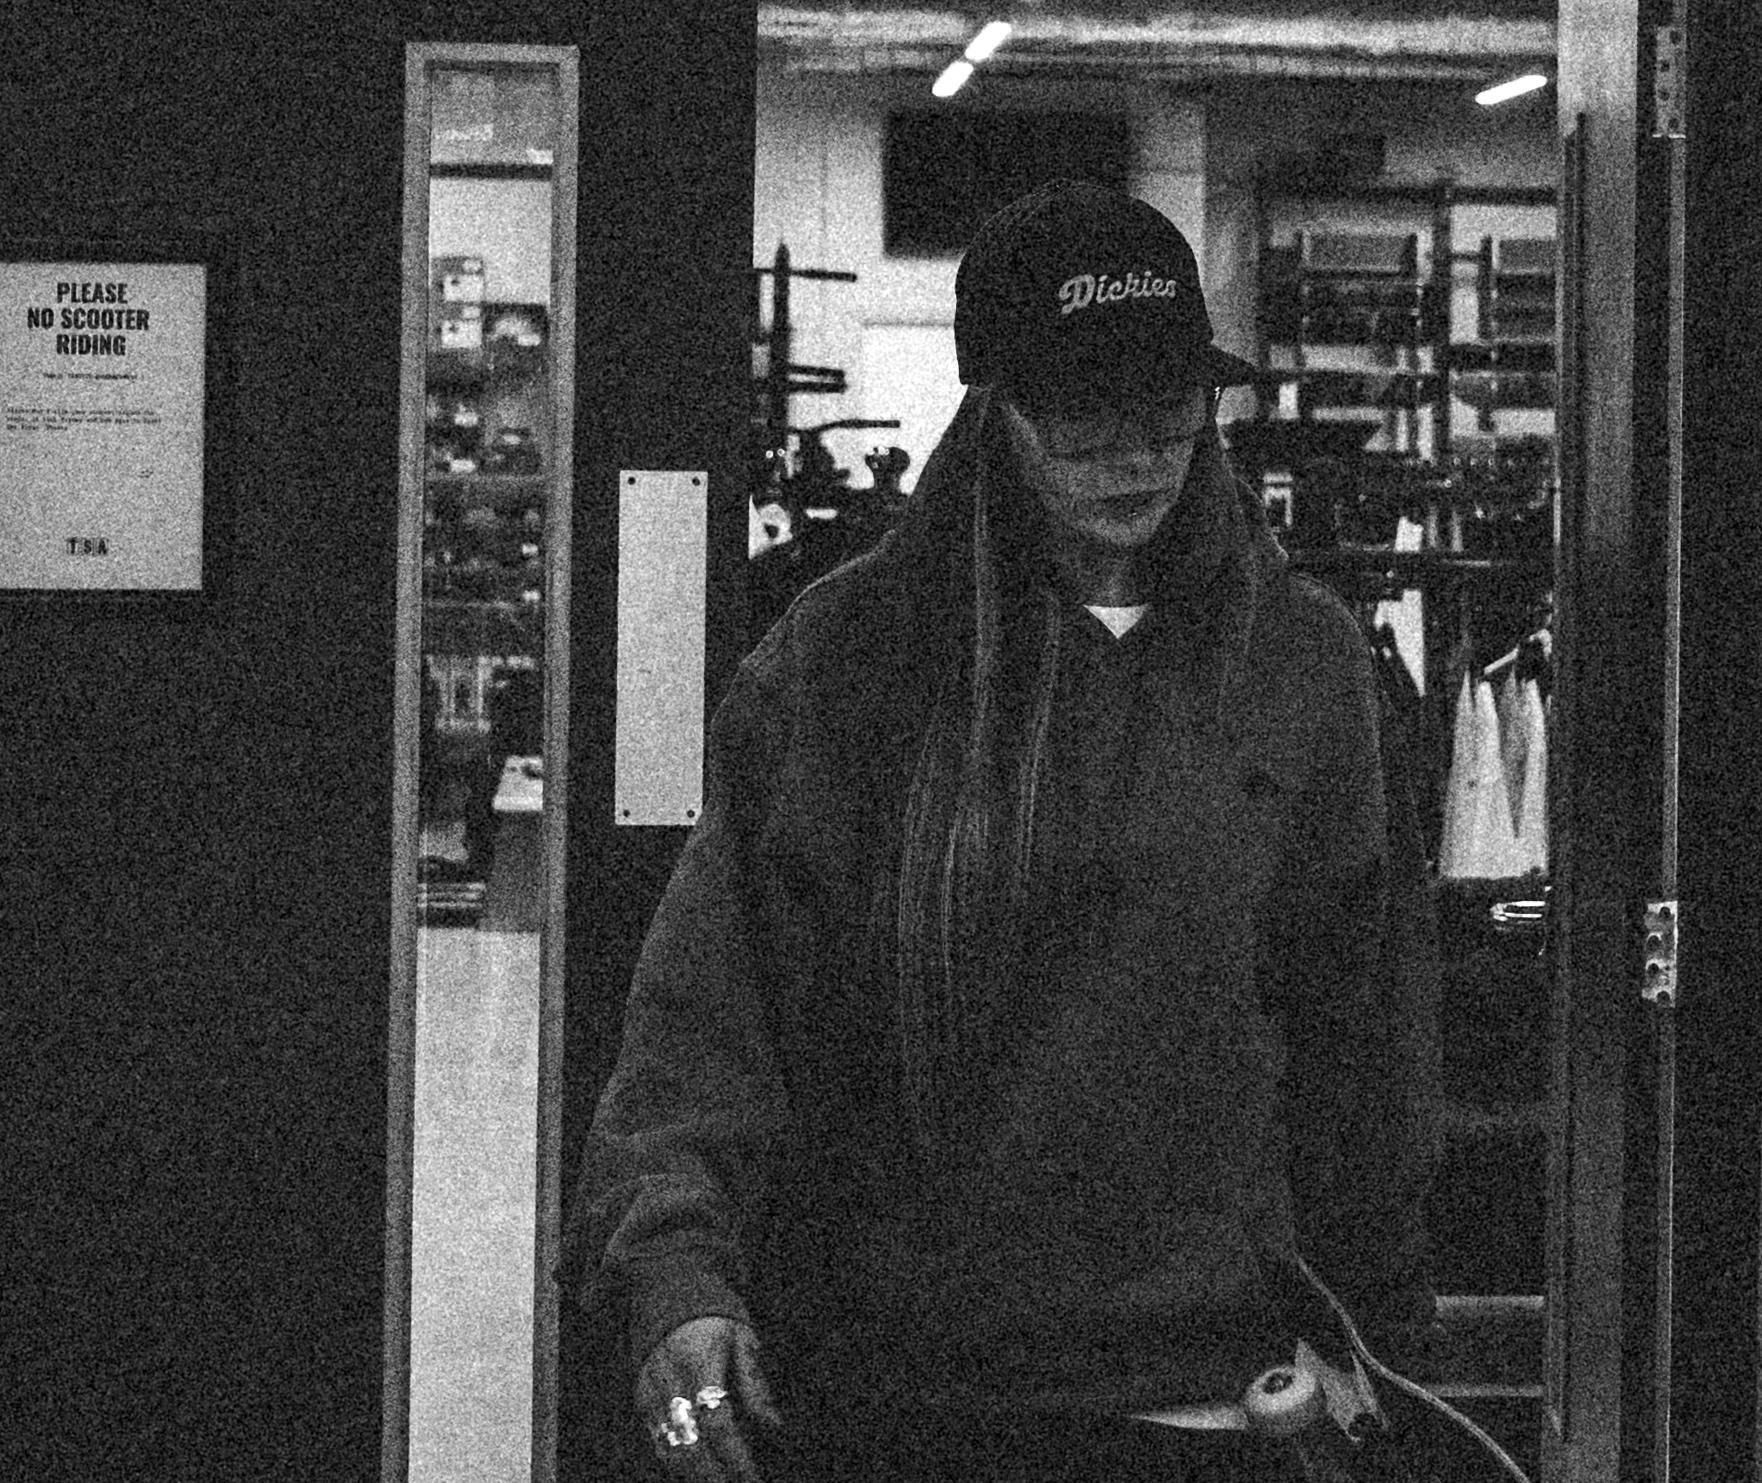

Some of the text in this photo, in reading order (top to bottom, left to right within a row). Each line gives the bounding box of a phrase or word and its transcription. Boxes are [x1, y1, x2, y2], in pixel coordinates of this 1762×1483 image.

[56, 282, 129, 304] PLEASE
[1057, 271, 1177, 314] Dickies
[27, 307, 150, 331] NO SCOOTER
[56, 334, 126, 356] RIDING
[66, 537, 108, 555] TSA
